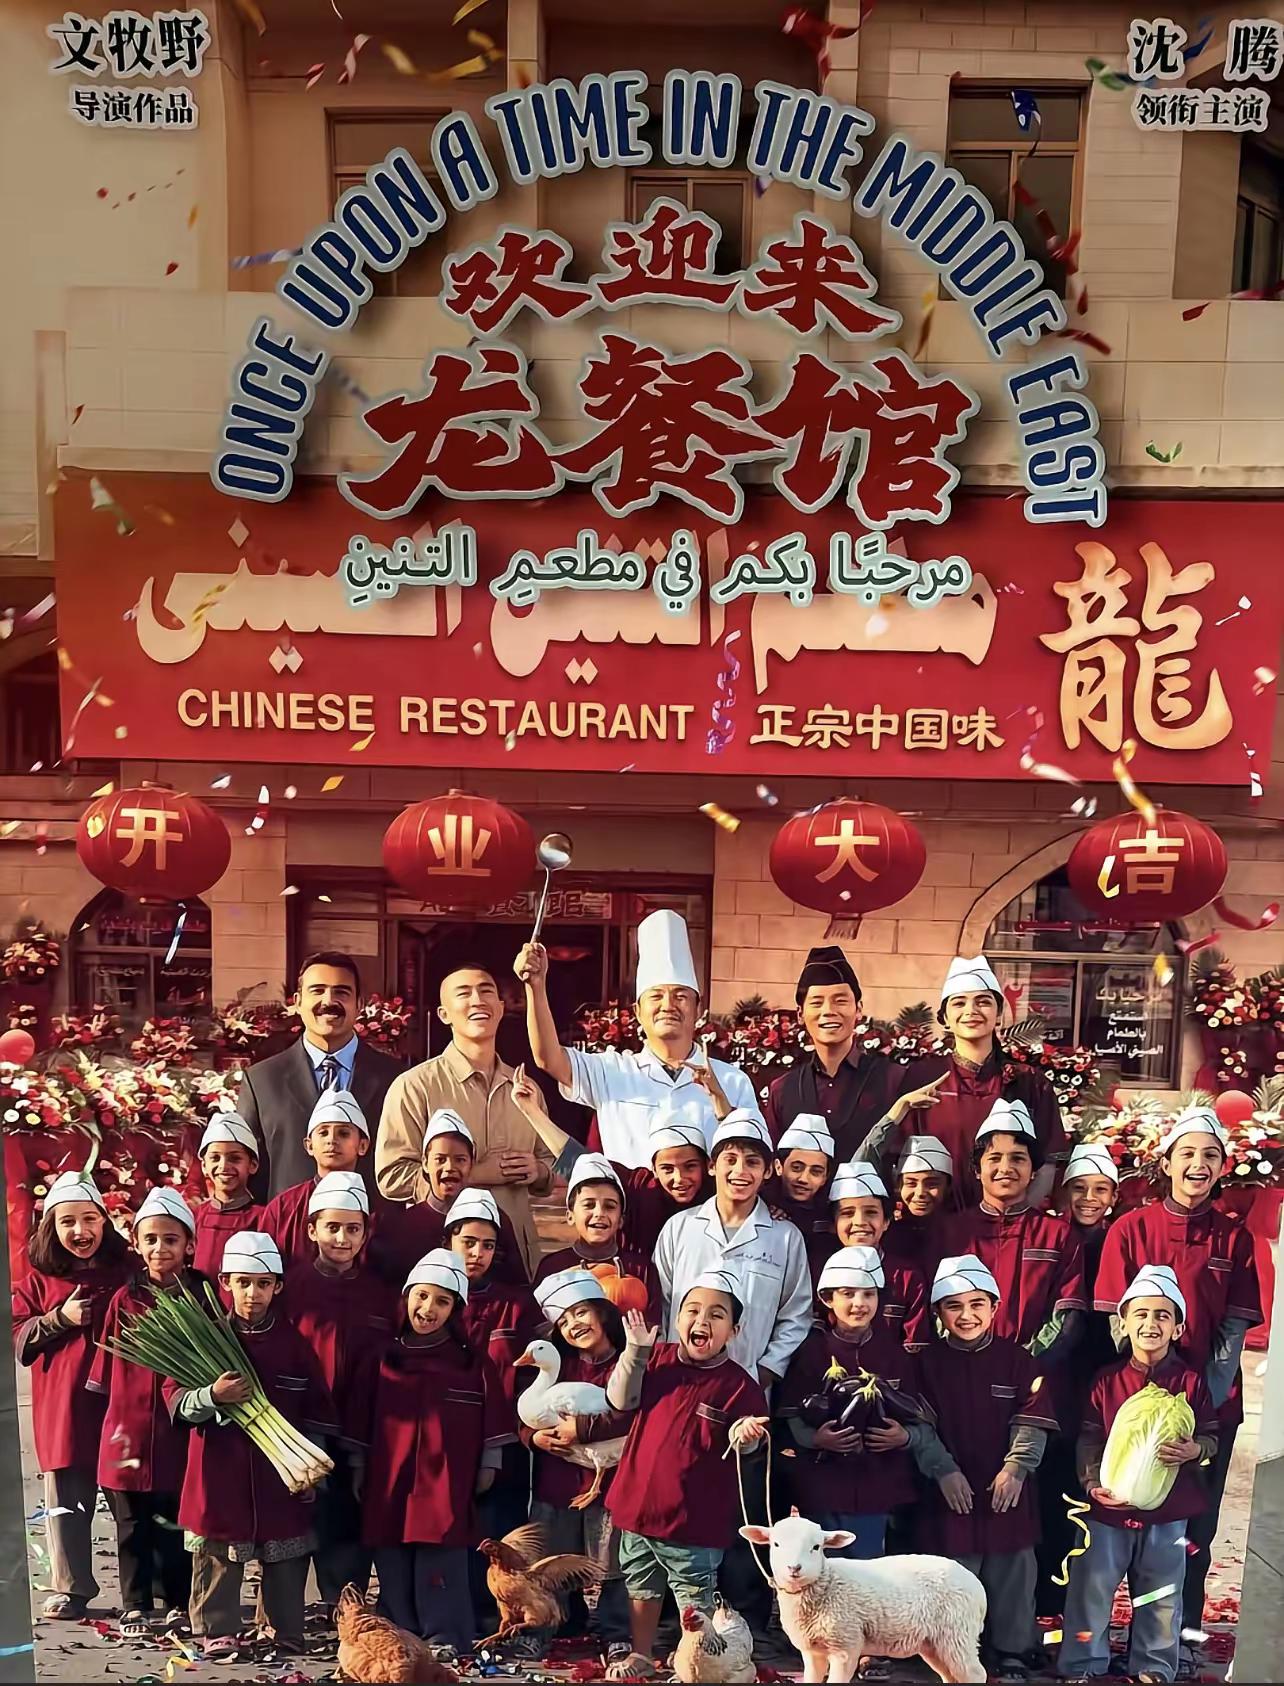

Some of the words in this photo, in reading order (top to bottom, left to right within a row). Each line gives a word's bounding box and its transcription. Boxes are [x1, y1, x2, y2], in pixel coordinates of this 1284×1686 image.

[52, 16, 205, 72] 文牧野
[72, 91, 193, 123] 导演作品
[1136, 94, 1265, 126] 领衔主演
[218, 321, 323, 497] ONCE
[281, 154, 438, 329] UPON
[439, 119, 489, 202] A
[493, 79, 647, 177] TIME
[669, 78, 736, 160] IN
[754, 88, 868, 193] THE
[861, 141, 1061, 356] MIDDLE
[1008, 355, 1102, 522] EAST
[445, 205, 897, 333] 欢迎来
[345, 335, 973, 521] 龙餐馆
[660, 535, 695, 609] في
[718, 539, 812, 602] بكم
[837, 538, 965, 601] مرحبًا
[1039, 541, 1234, 752] 龍
[177, 689, 375, 733] CHINESE
[399, 697, 695, 742] RESTAURANT
[749, 703, 1005, 752] 正宗中国味
[116, 807, 184, 871] 开
[426, 813, 492, 877] 业
[813, 819, 880, 884] 大
[1118, 829, 1186, 895] 吉
